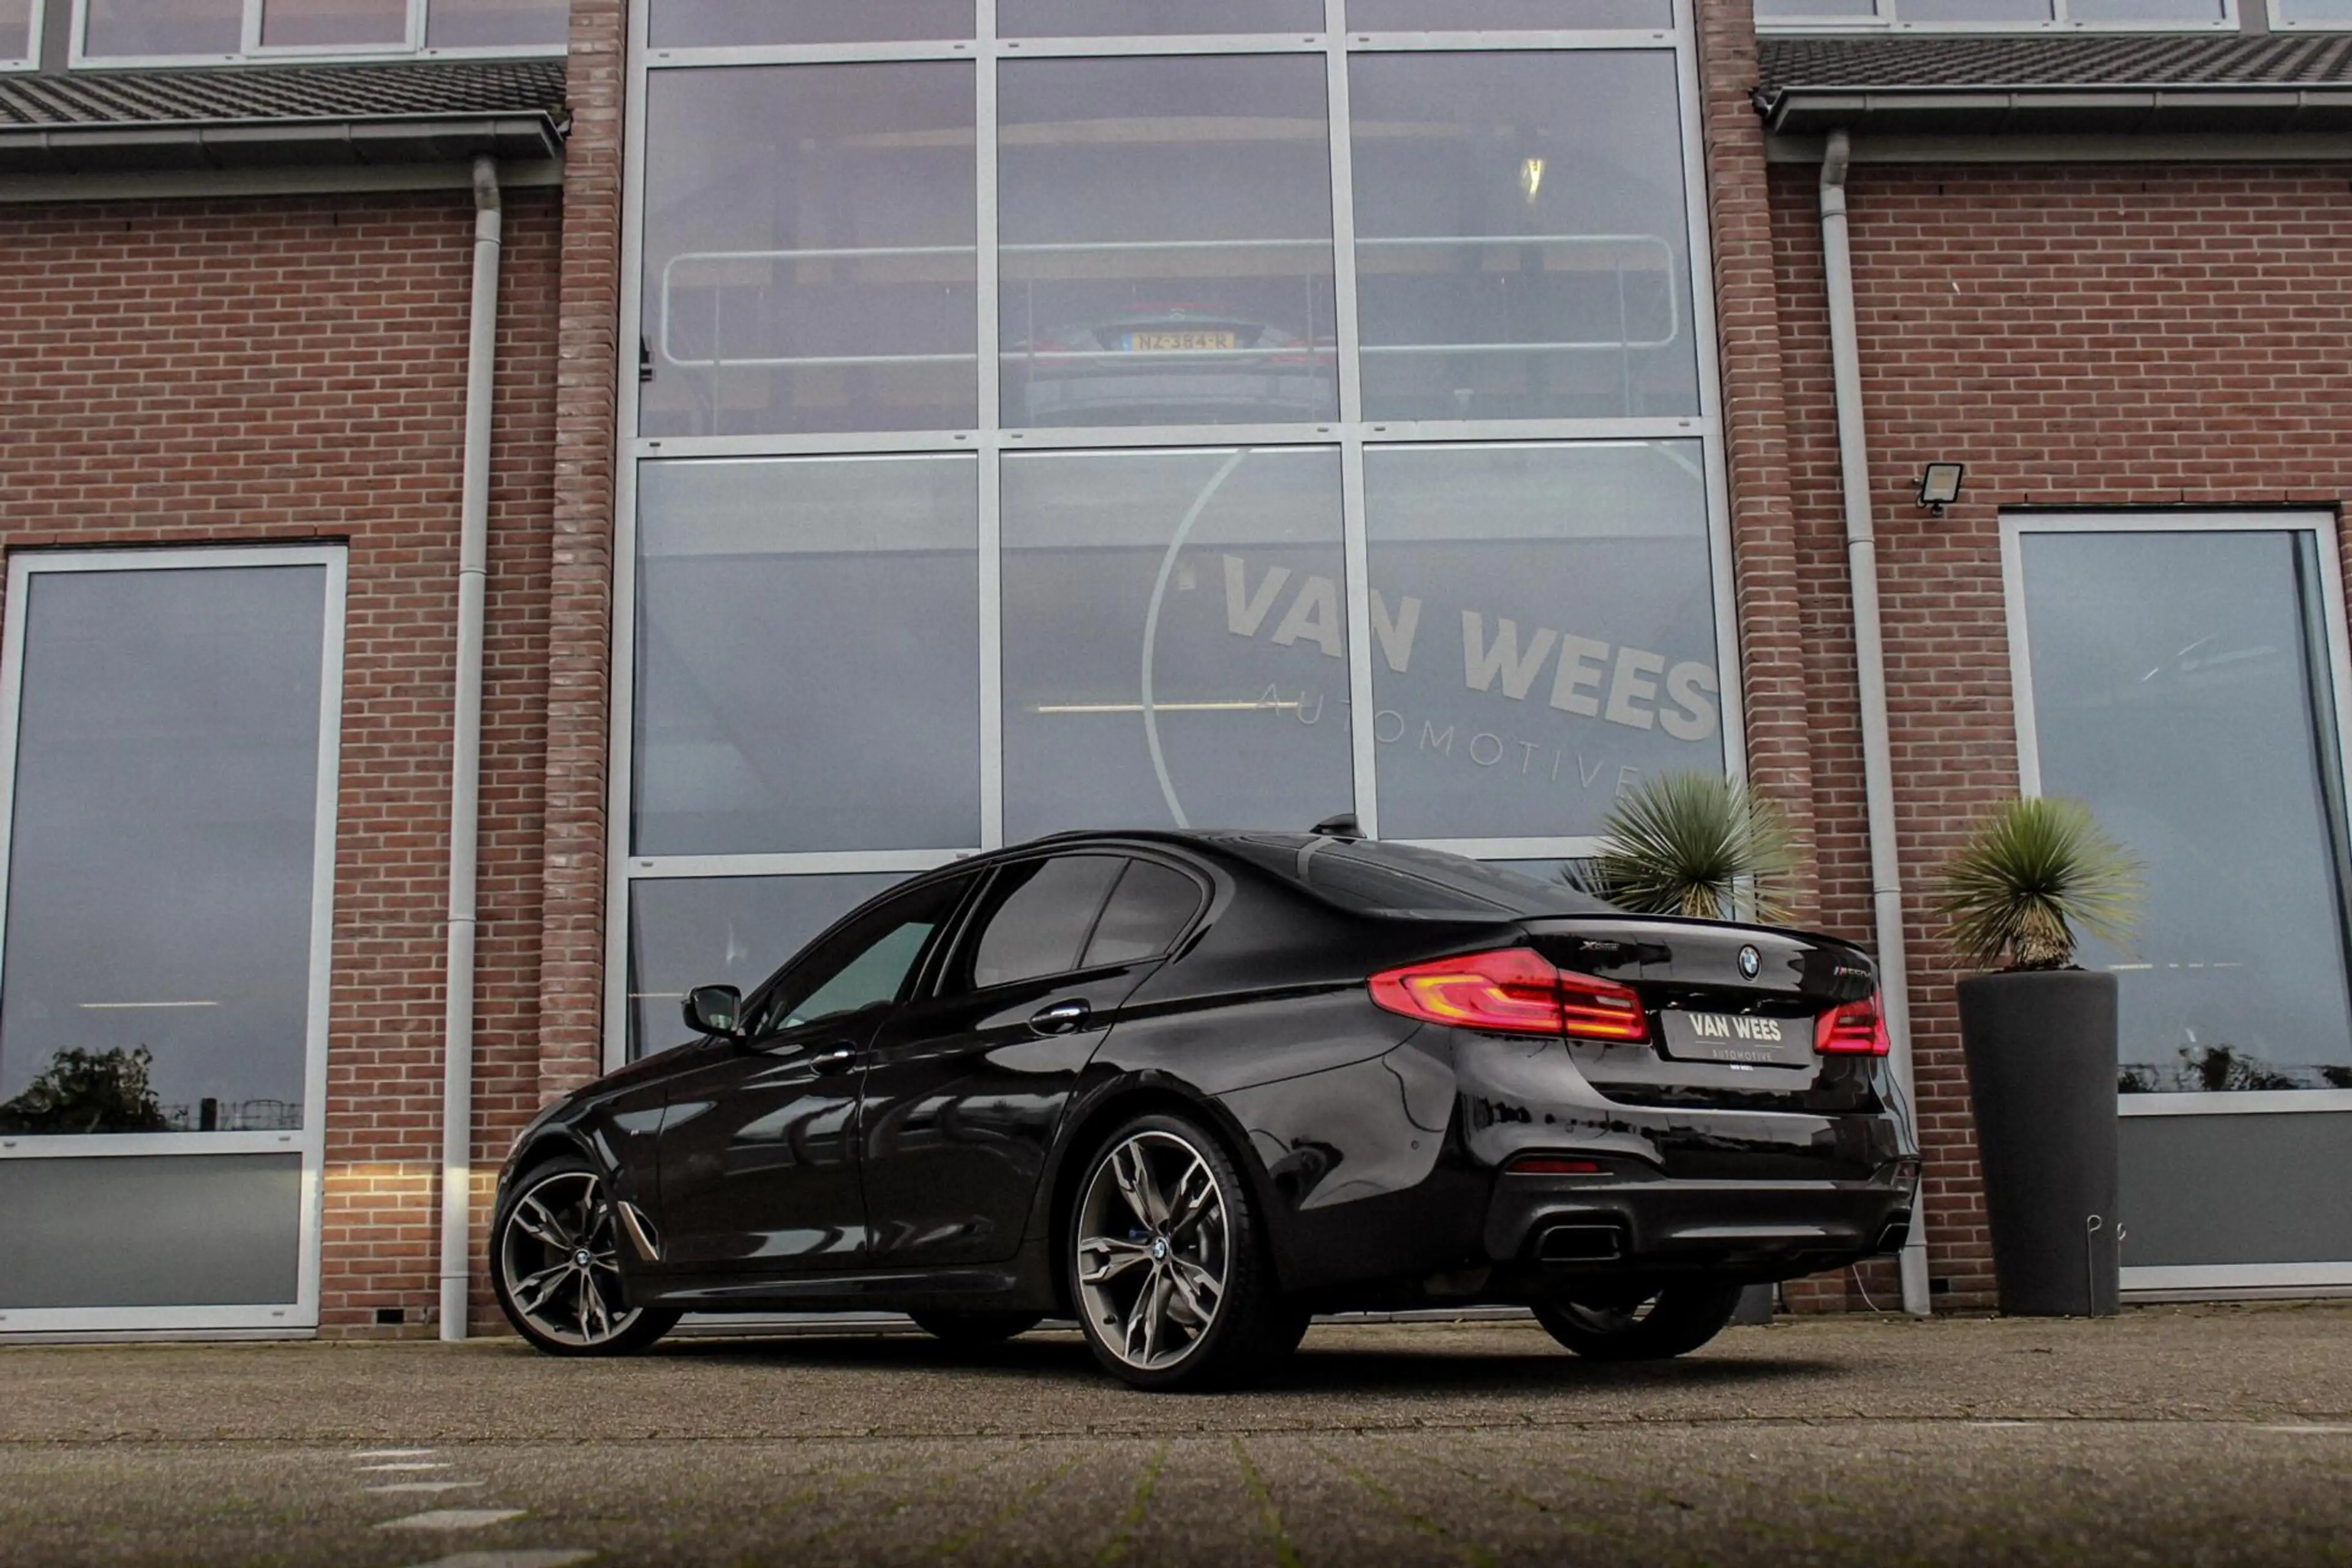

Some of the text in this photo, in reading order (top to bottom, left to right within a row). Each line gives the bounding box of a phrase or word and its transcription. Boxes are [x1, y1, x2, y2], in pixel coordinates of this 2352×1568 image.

[1223, 554, 1719, 742] VAN WEES
[1689, 1013, 1782, 1041] VAN WEES
